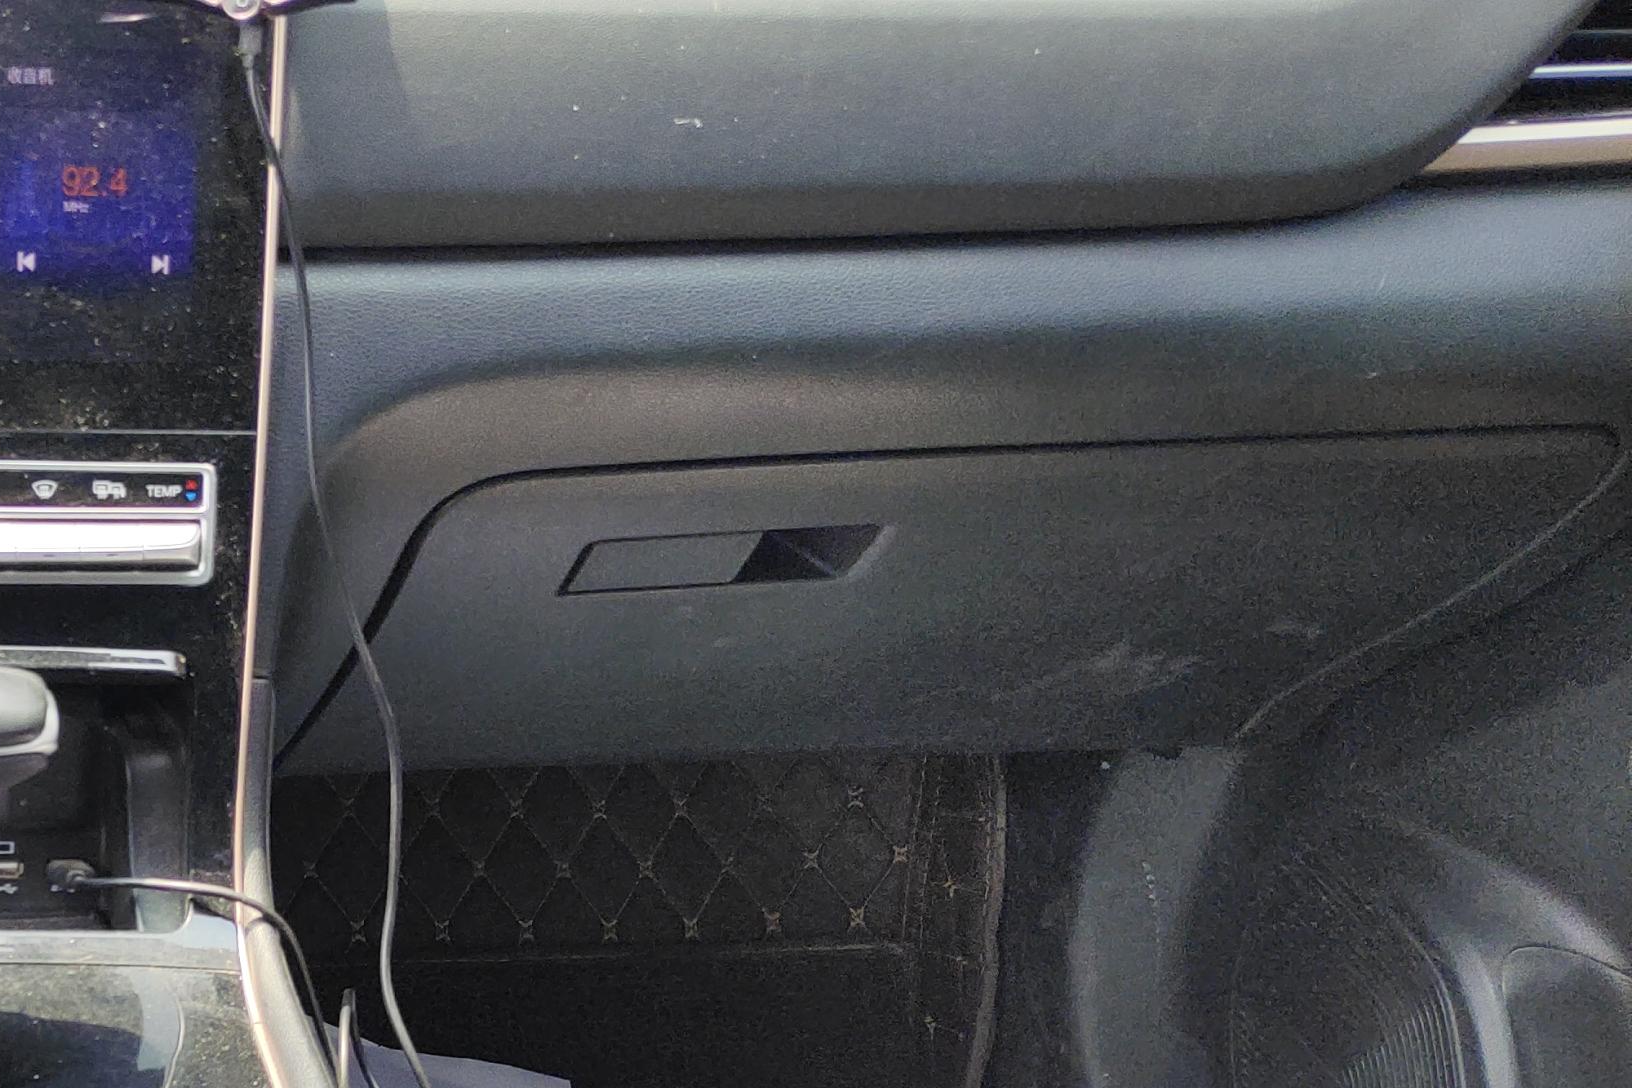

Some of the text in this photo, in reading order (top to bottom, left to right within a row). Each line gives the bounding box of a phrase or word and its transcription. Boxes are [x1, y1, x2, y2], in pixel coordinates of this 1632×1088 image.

[6, 66, 54, 86] 收音机
[62, 166, 128, 197] 92.4
[145, 484, 182, 498] TEMP
